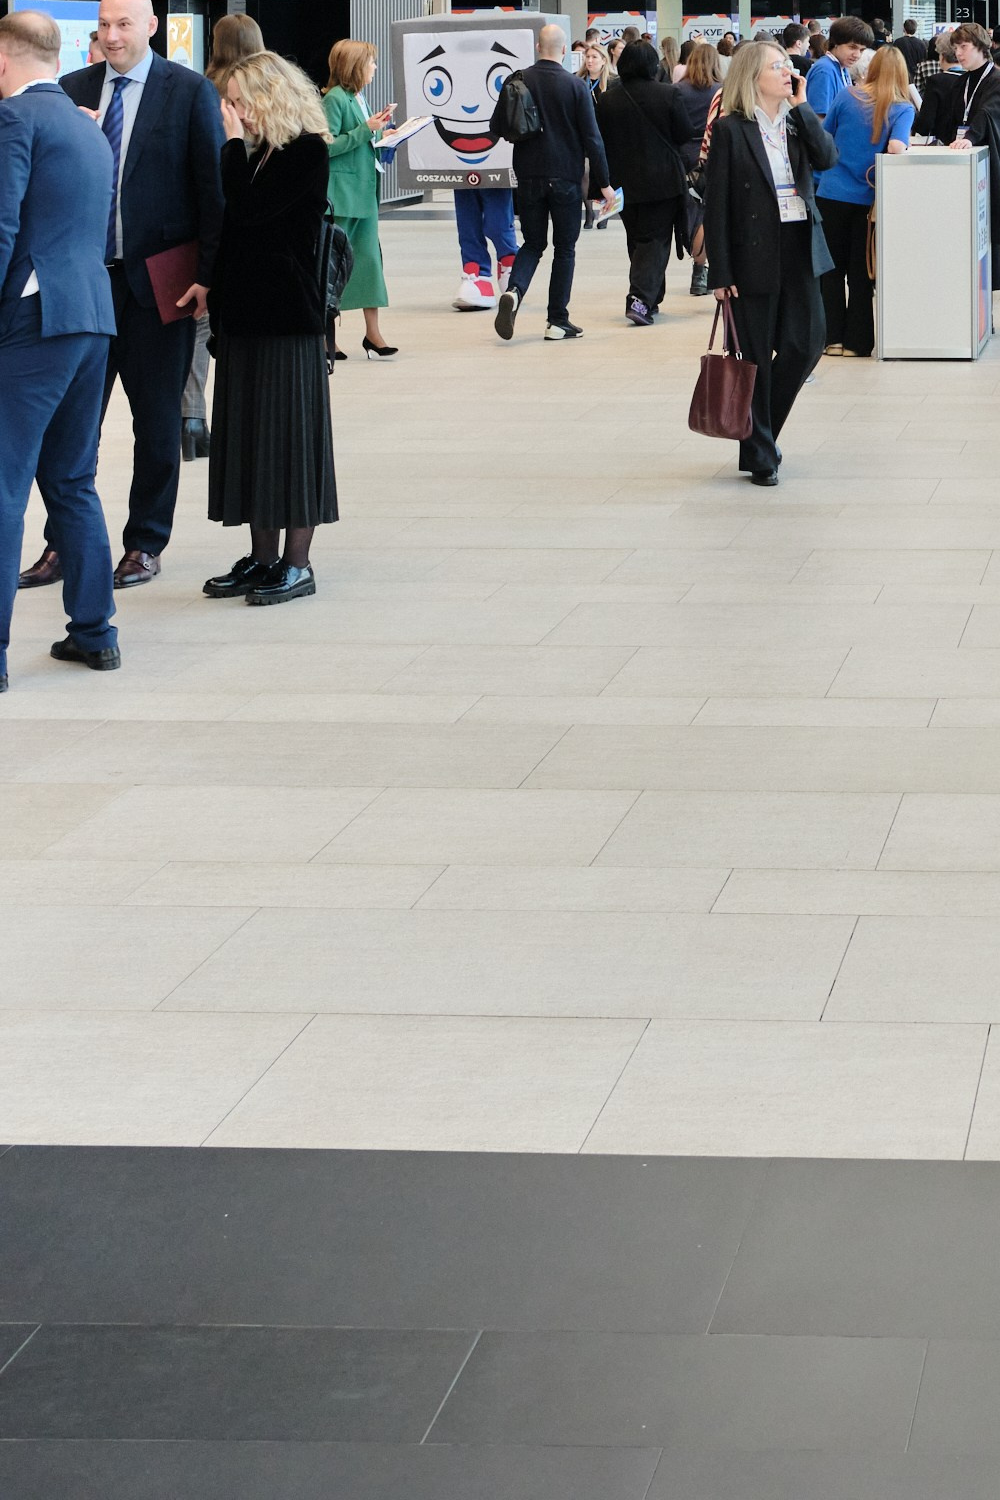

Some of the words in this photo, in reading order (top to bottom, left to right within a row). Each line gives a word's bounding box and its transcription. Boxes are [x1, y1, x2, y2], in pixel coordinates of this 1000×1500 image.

[956, 8, 970, 18] 23
[703, 28, 723, 36] КУБ
[489, 174, 501, 182] TV
